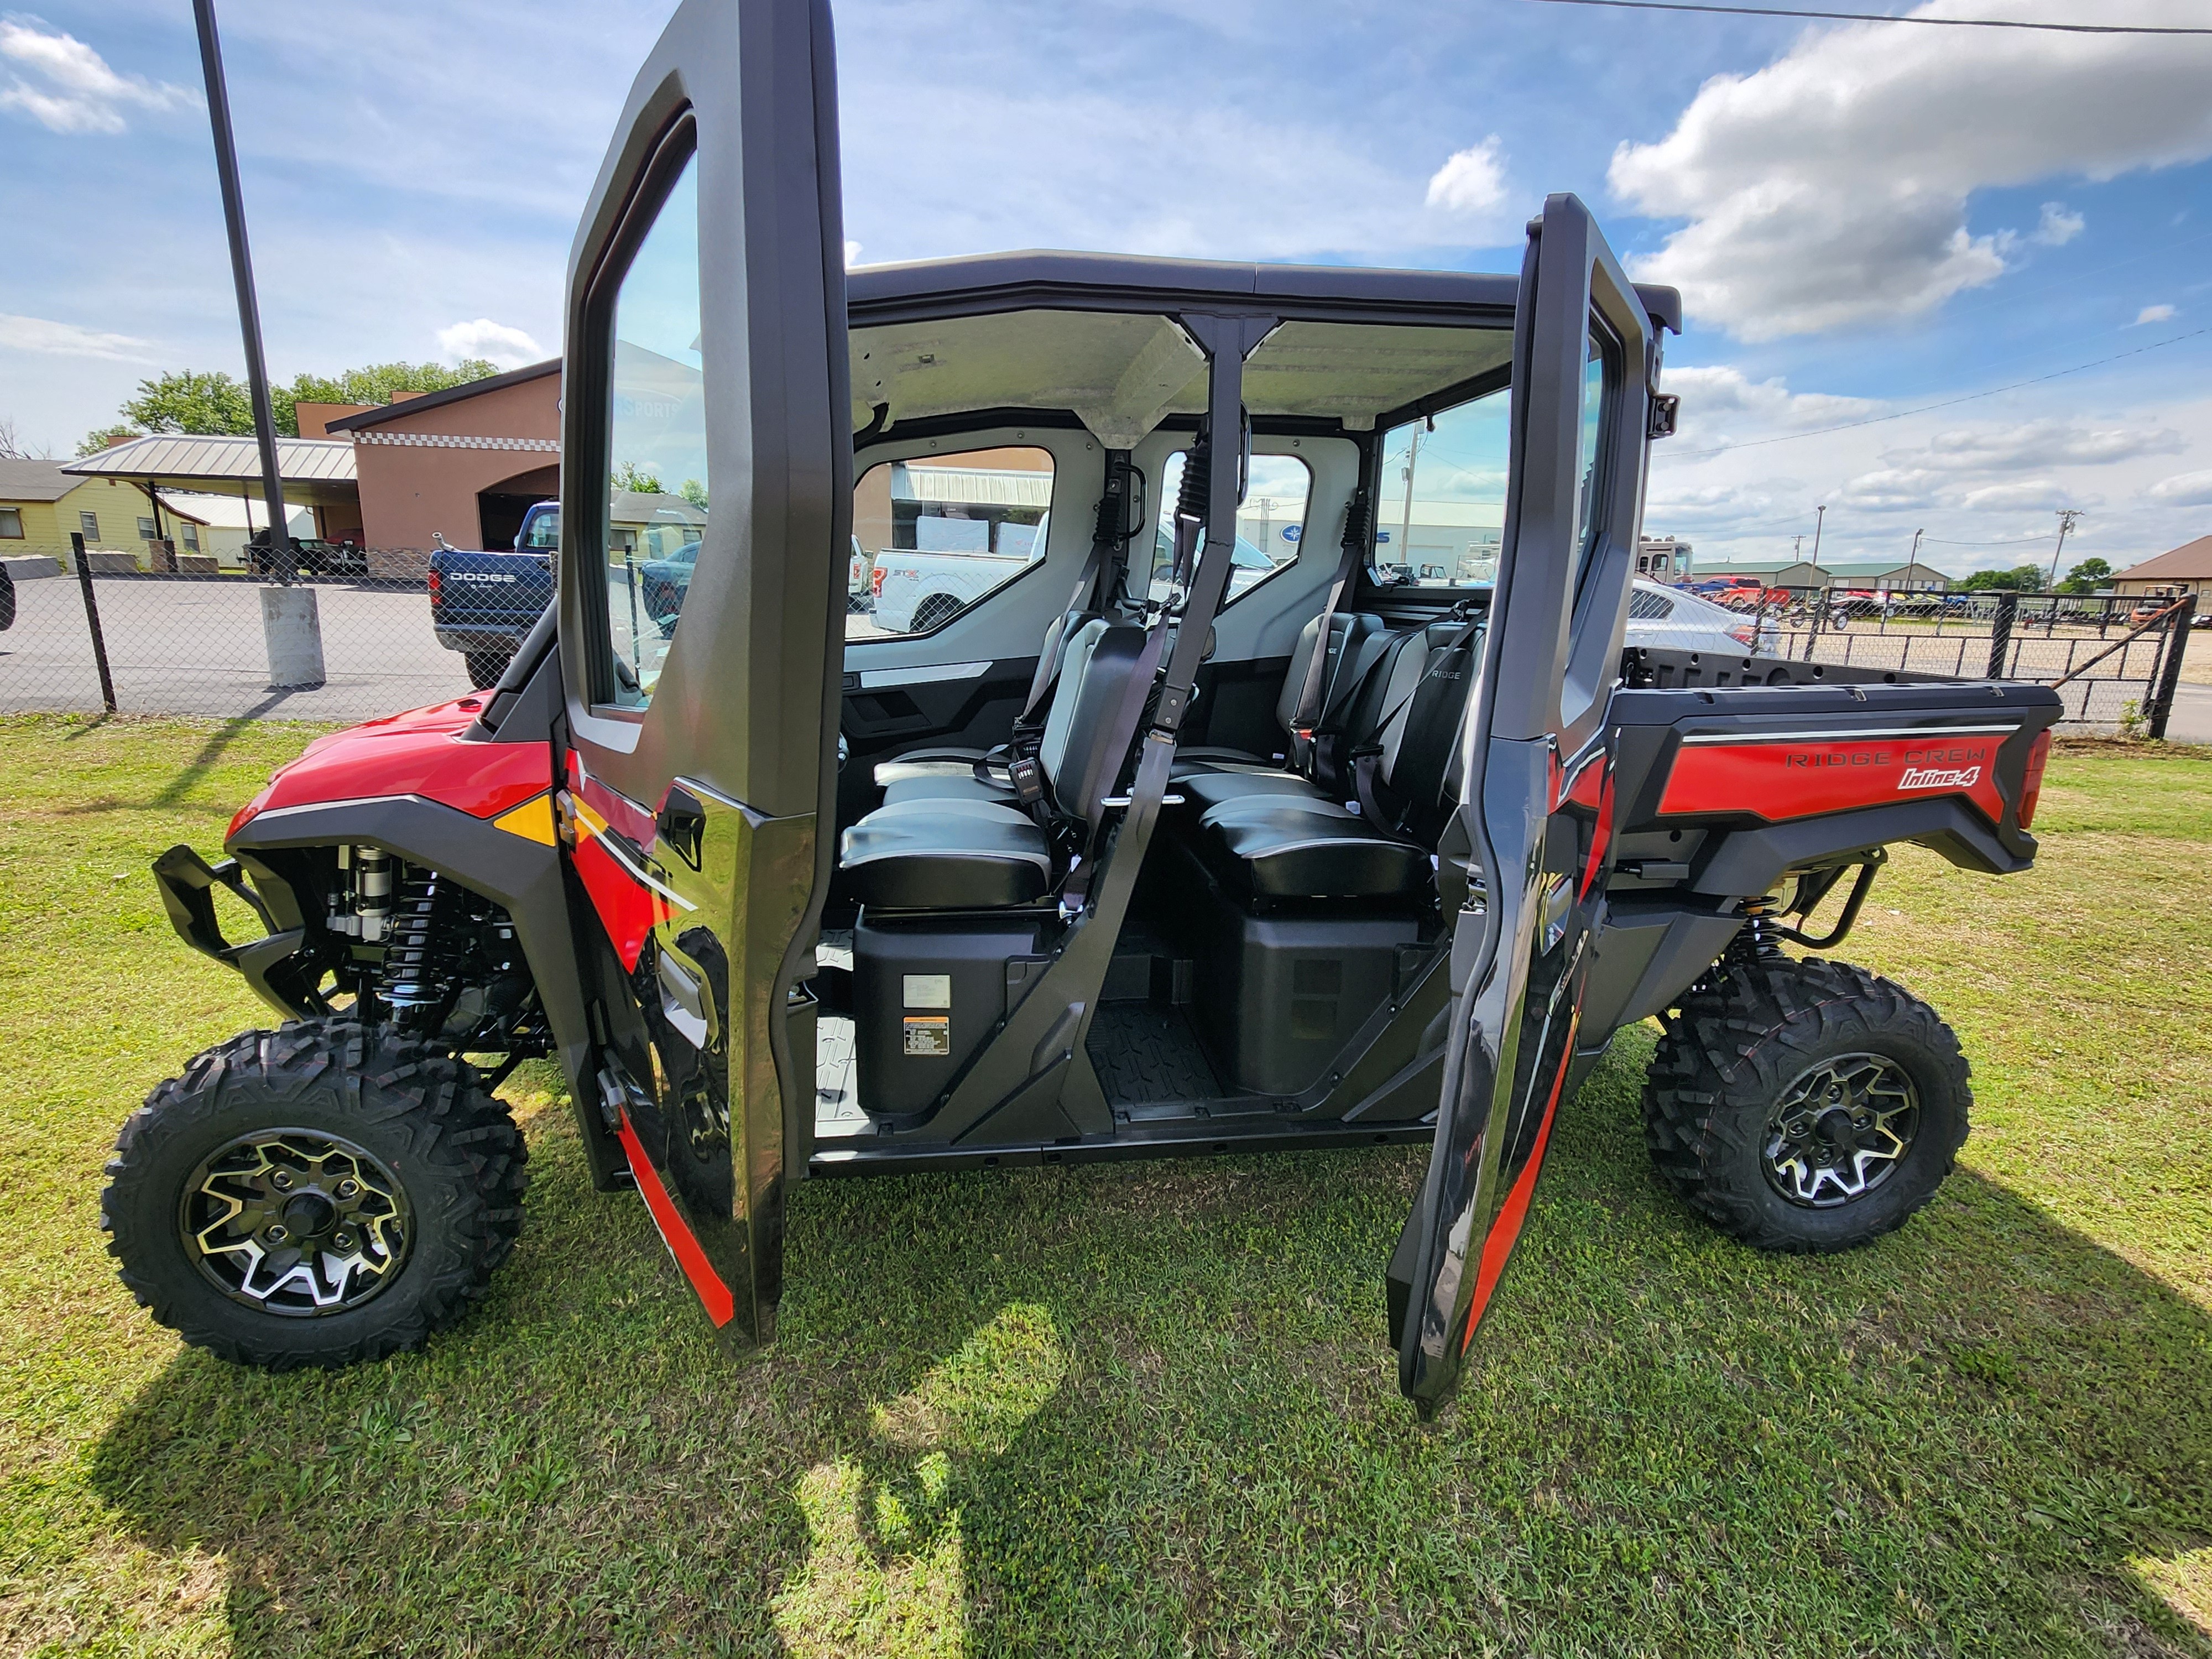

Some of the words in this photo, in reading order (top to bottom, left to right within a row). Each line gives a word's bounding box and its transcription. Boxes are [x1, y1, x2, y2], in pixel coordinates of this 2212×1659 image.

[450, 572, 516, 582] DODGE
[1432, 670, 1461, 680] RIDGE
[1786, 752, 1891, 768] RIDGE
[1905, 748, 1986, 764] CREW
[1897, 766, 1981, 790] Inline-4
